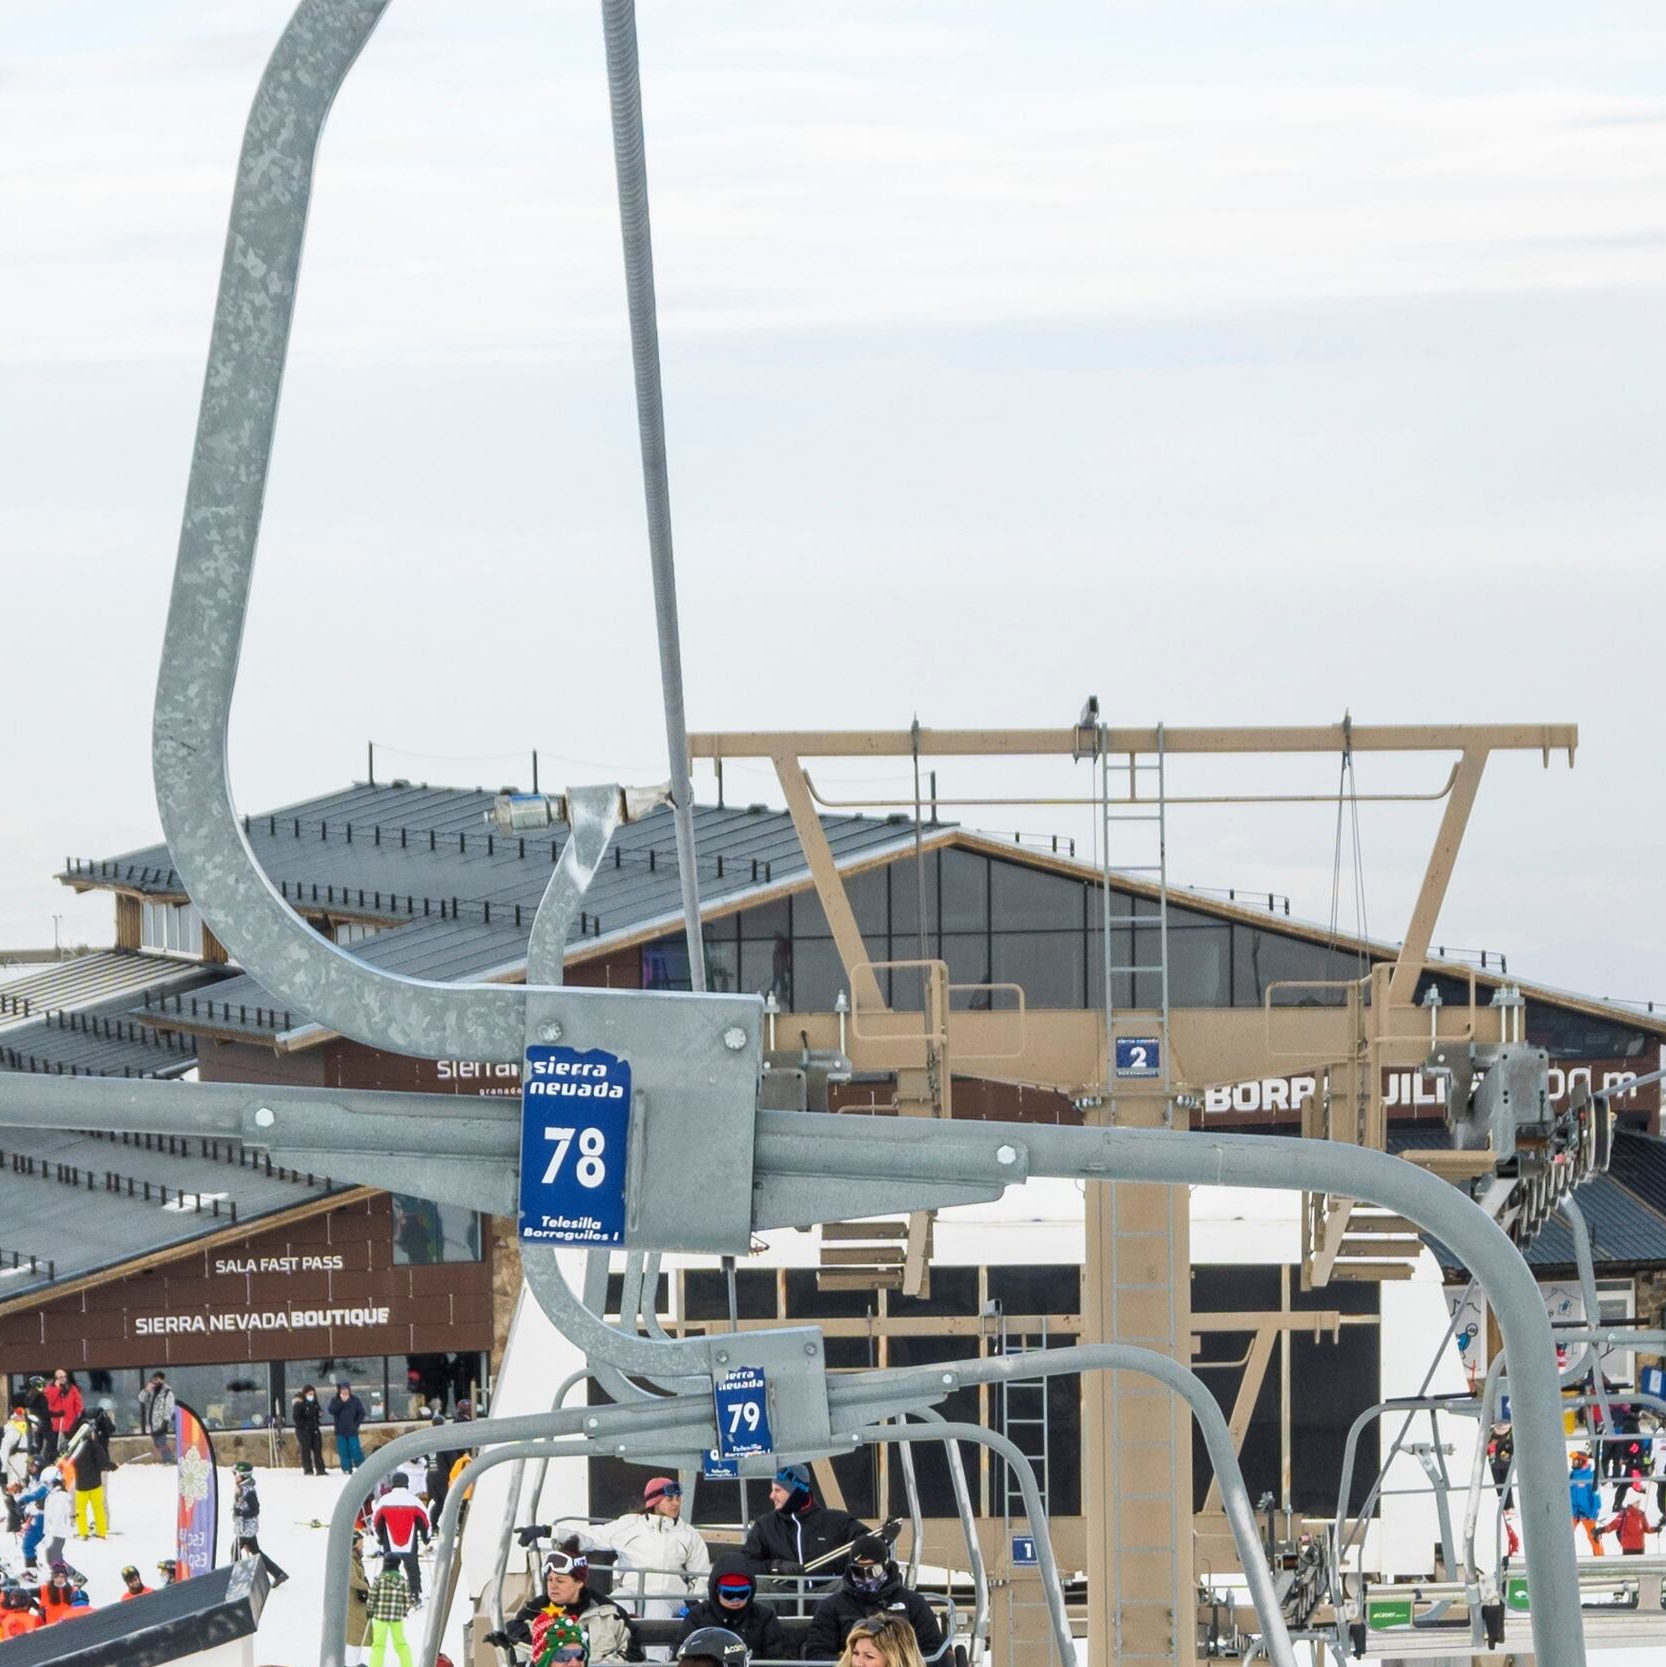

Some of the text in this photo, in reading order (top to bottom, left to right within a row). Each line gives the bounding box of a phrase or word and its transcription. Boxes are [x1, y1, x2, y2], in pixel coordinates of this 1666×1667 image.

[533, 1056, 607, 1078] sierra
[1130, 1046, 1147, 1068] 2
[530, 1081, 624, 1098] nevada
[541, 1126, 606, 1188] 78
[541, 1215, 602, 1230] Telesilla
[523, 1227, 609, 1241] Borreguiles
[216, 1255, 343, 1274] SALA FAST PASS
[135, 1307, 390, 1334] SIERRA NEVADA BOUTIQUE
[727, 1401, 760, 1433] 79
[1024, 1543, 1032, 1558] 1
